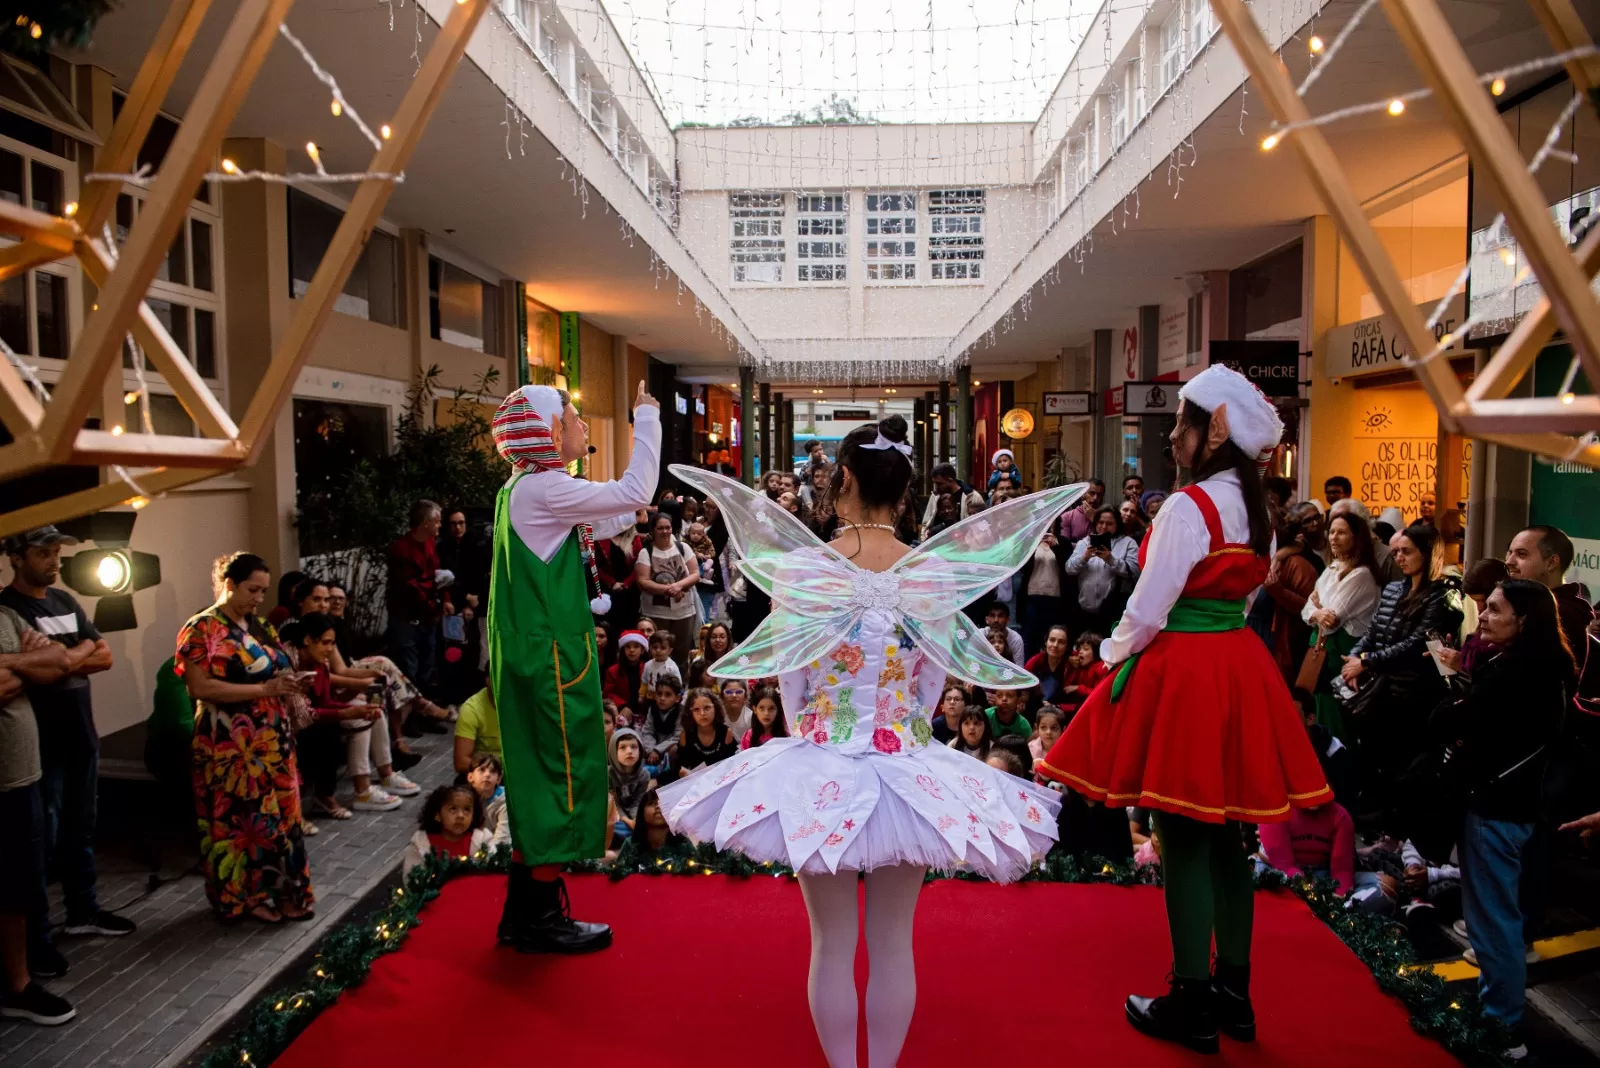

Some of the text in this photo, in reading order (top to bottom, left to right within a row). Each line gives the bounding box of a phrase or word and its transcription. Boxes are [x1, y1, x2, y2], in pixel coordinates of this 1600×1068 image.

[1354, 320, 1381, 339] ÓTICAS
[1352, 335, 1387, 368] RAFA
[1248, 365, 1296, 378] CHICRE
[1378, 441, 1395, 462] OS
[1400, 441, 1438, 461] OLHO
[1362, 462, 1438, 481] CANDEIA D
[1361, 482, 1380, 502] SE
[1383, 482, 1402, 502] OS
[1572, 549, 1600, 570] MÁCI
